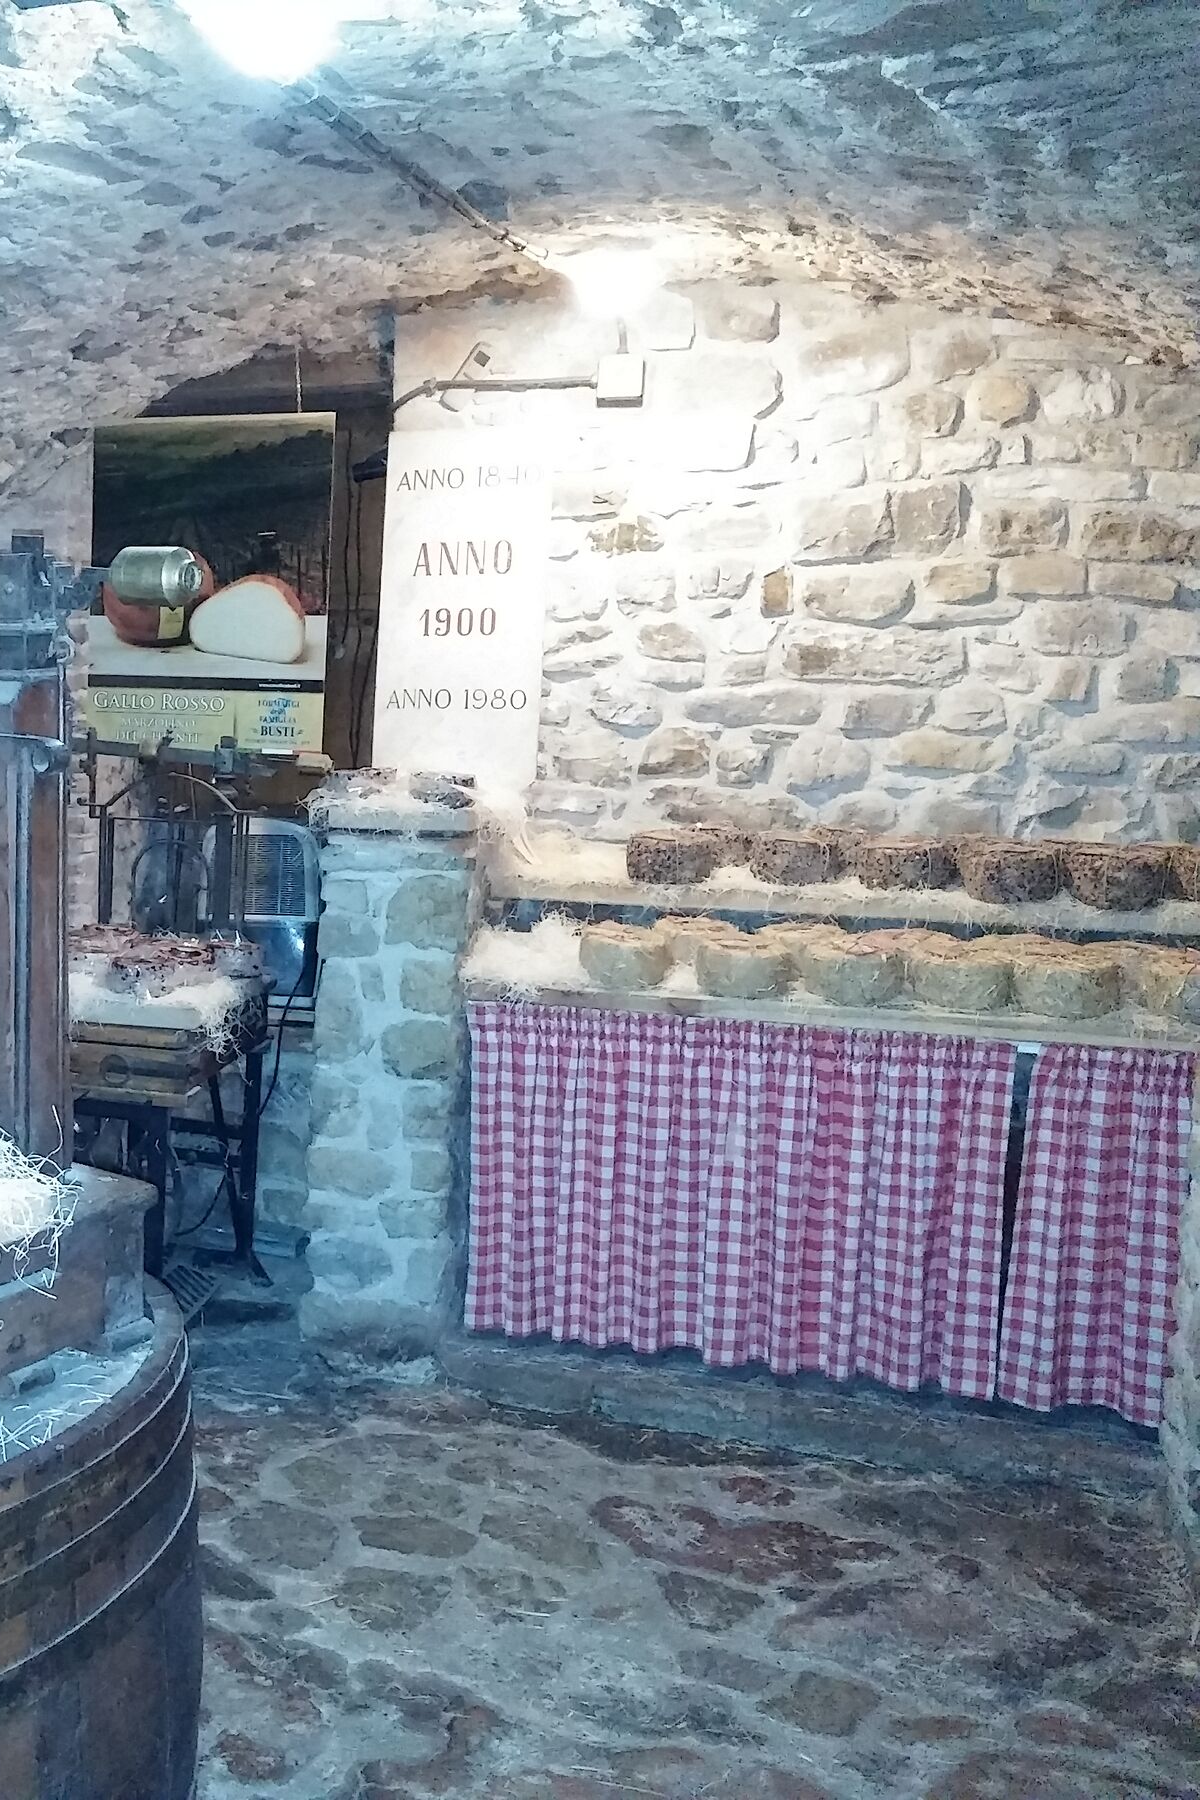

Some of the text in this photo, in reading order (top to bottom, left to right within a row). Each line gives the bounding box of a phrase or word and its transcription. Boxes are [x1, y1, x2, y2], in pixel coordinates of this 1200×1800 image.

[396, 467, 465, 492] ANNO
[413, 539, 513, 577] ANNO
[418, 607, 497, 637] 1900
[93, 691, 226, 713] GALLO ROSSO
[386, 688, 528, 711] ANNO 1980
[260, 725, 296, 738] BUSTI
